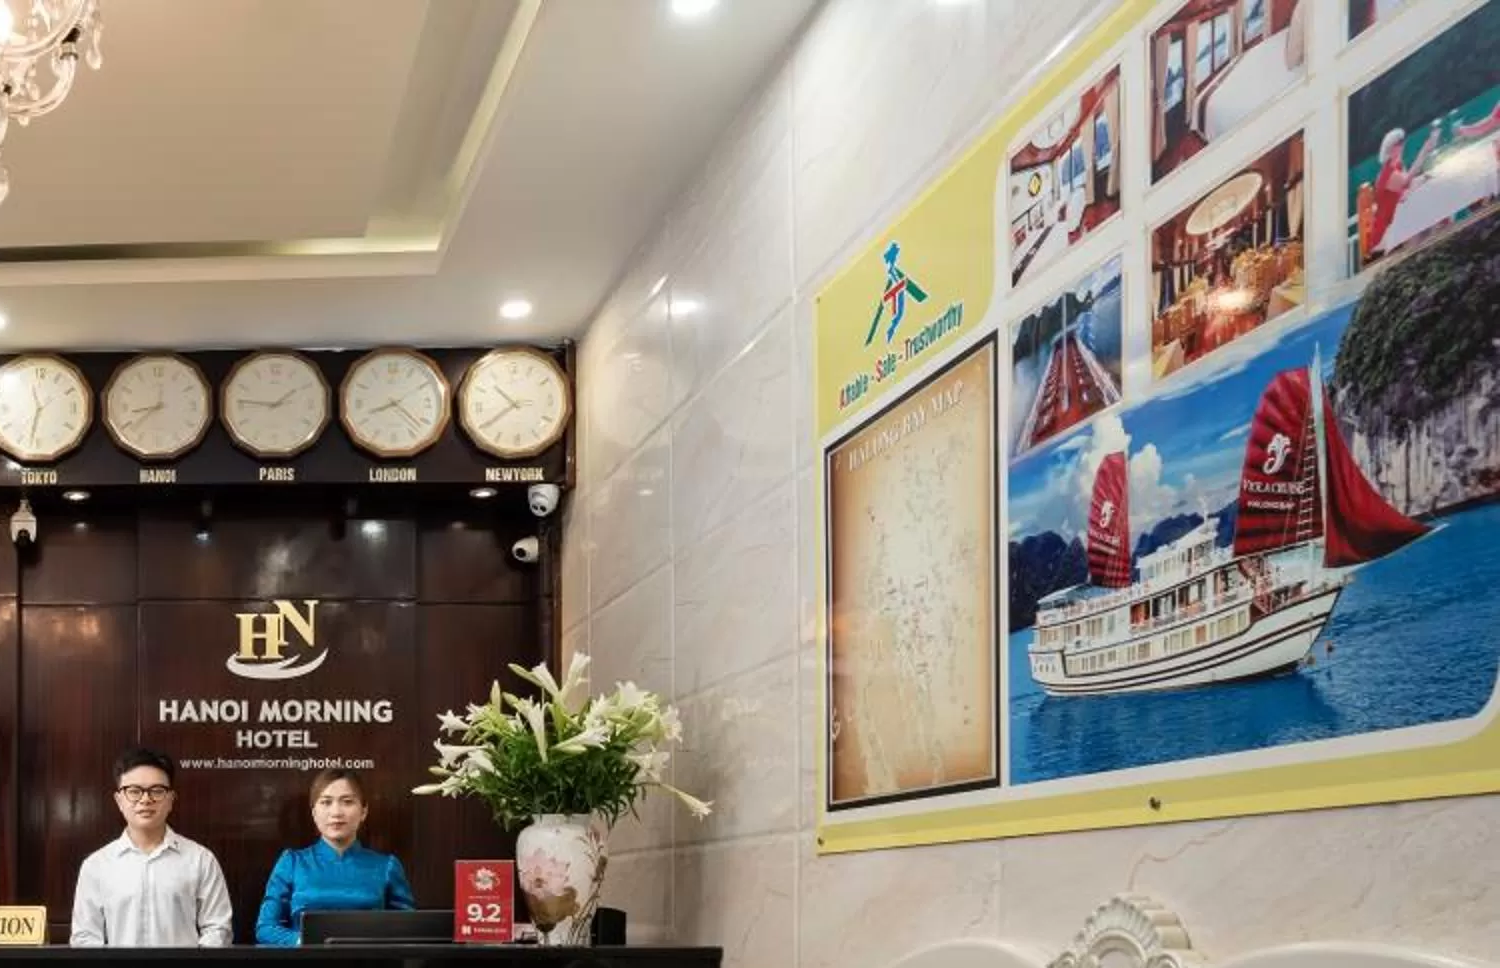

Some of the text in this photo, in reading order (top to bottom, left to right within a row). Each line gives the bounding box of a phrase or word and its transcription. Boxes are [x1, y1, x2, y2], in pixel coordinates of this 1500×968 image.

[904, 302, 963, 361] Trustworthy
[21, 469, 58, 485] TOKYO
[139, 469, 177, 484] HANOI
[259, 466, 295, 481] PARIS
[368, 467, 417, 482] LONDON
[485, 467, 545, 482] NEWYORK
[159, 700, 393, 723] HANOI MORNING
[236, 730, 318, 748] HOTEL
[180, 757, 374, 771] www.hanoimorninghotel.com
[467, 903, 501, 923] 9.2
